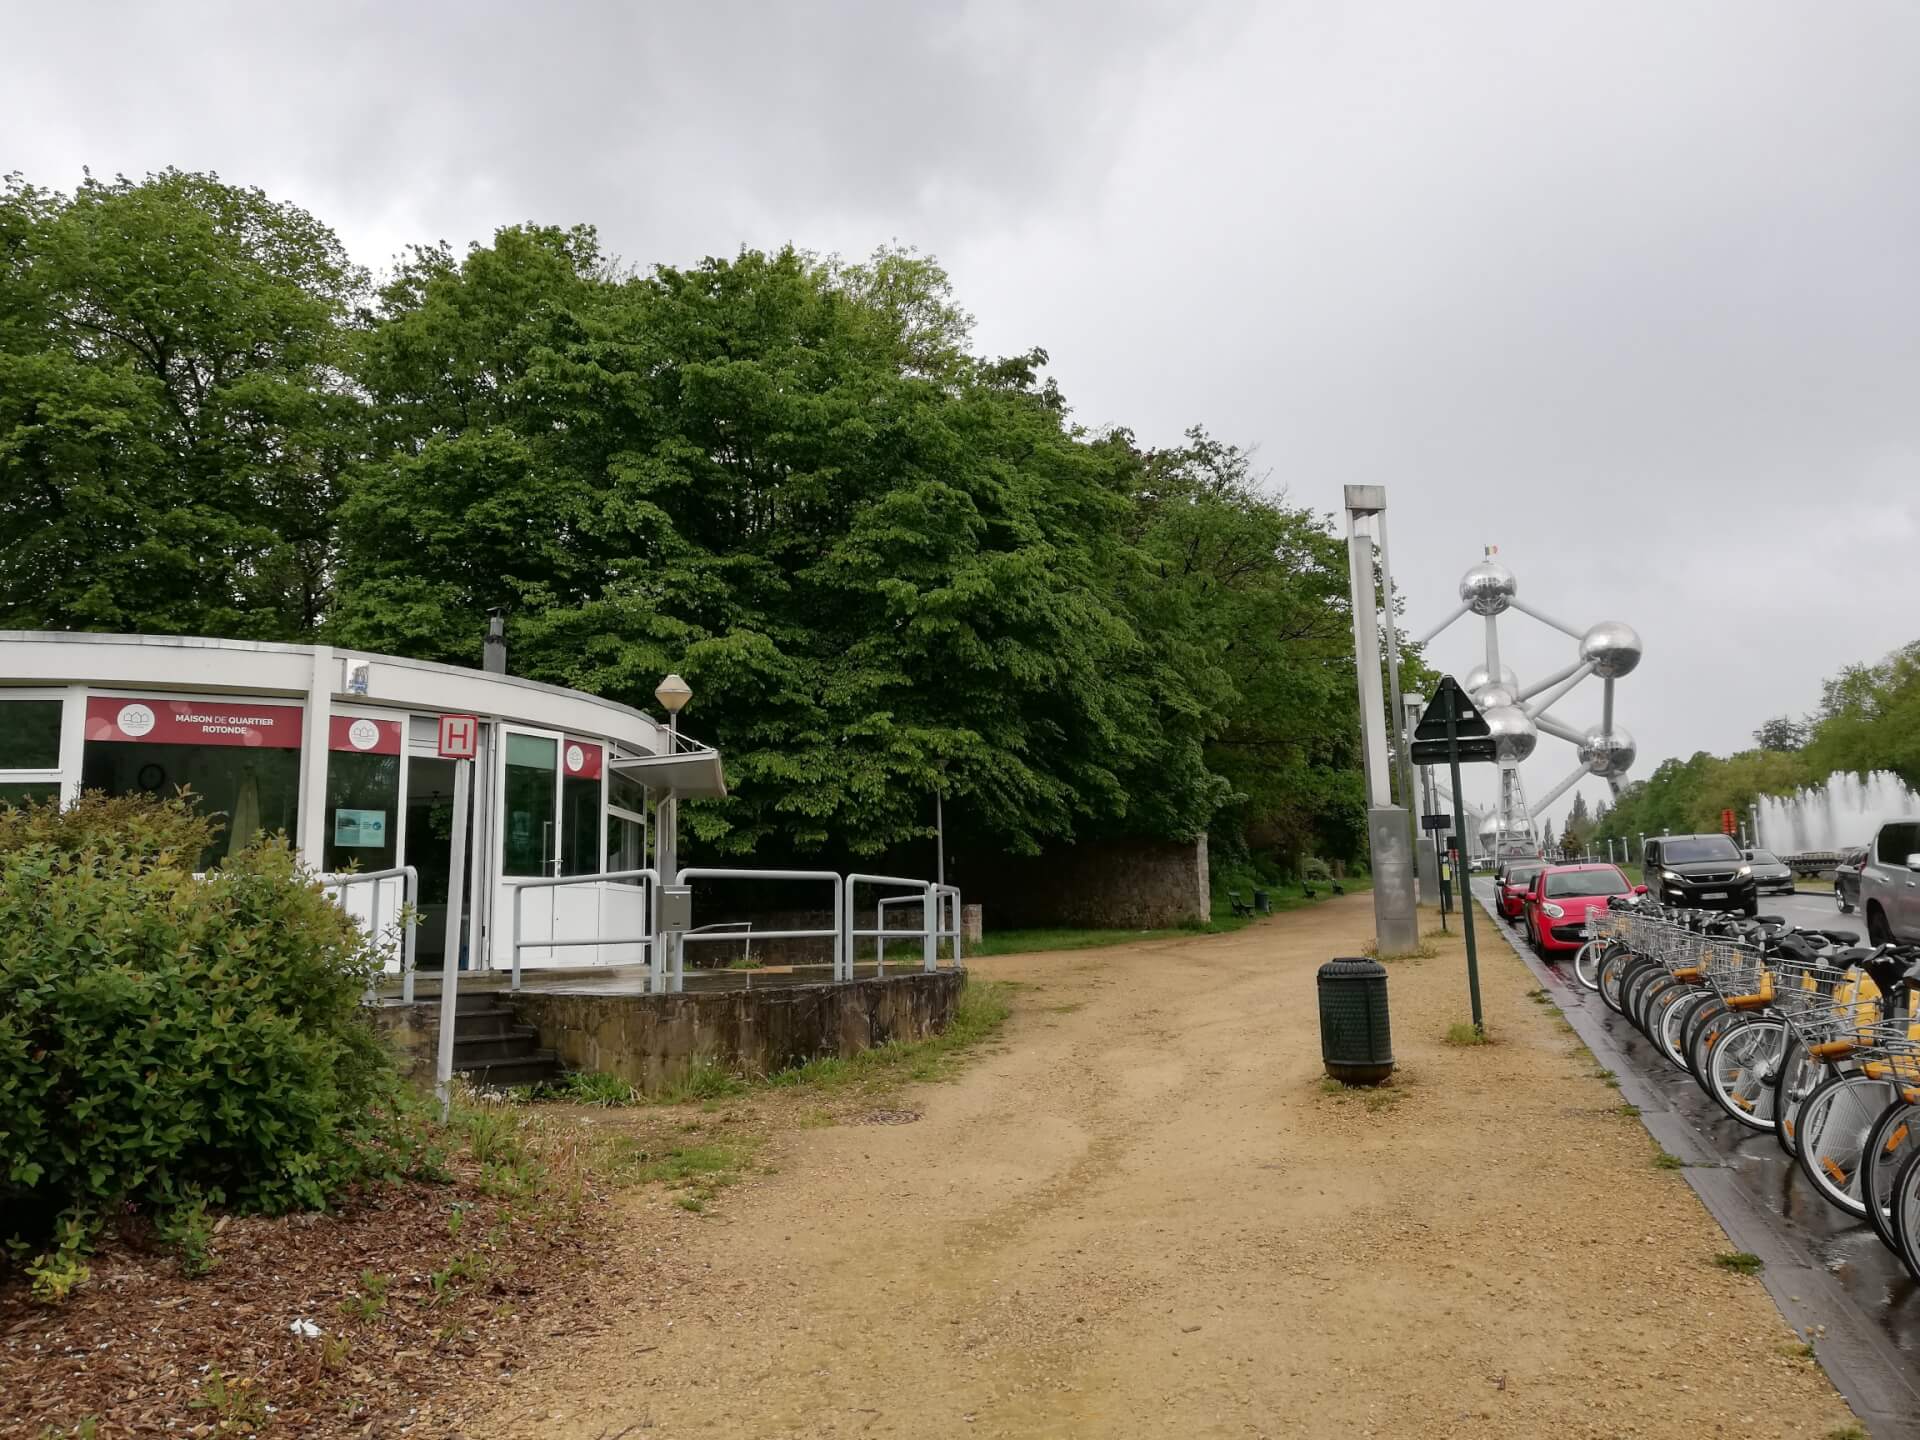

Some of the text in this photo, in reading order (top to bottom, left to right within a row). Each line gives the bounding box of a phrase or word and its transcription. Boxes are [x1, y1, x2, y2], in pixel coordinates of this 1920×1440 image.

[175, 714, 274, 726] MAISON DE QUARTIER
[202, 725, 248, 734] ROTONDE
[448, 723, 468, 749] H
